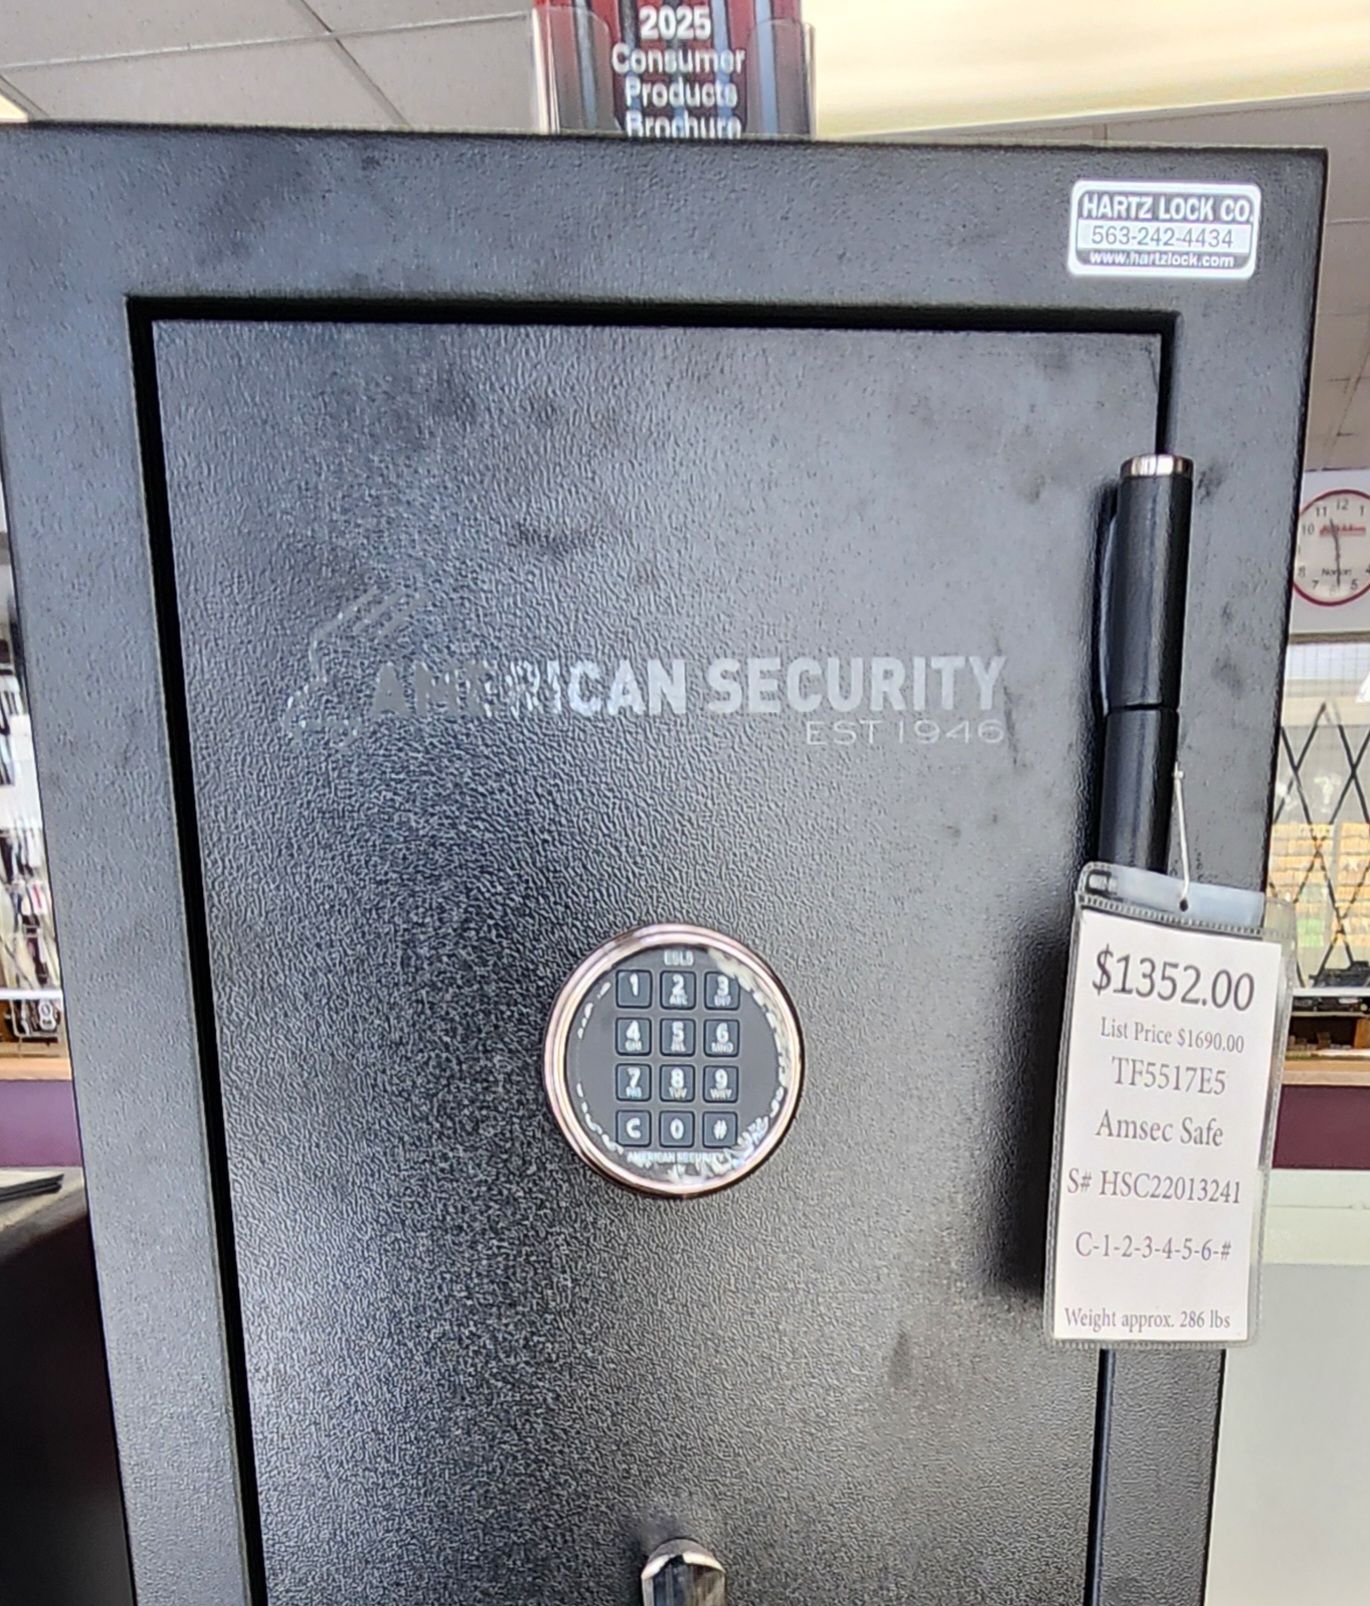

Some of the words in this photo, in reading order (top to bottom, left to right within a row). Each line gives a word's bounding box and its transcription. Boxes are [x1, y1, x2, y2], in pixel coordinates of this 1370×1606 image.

[638, 6, 712, 40] 2025
[611, 43, 746, 74] Consumer
[625, 76, 738, 109] Products
[1082, 193, 1153, 219] HARTZ
[1158, 195, 1214, 221] LOCK
[1091, 225, 1234, 248] 563-242-4434
[1089, 251, 1235, 268] www.hartzlock.com
[1315, 506, 1328, 518] 11
[1336, 499, 1349, 511] 12
[1302, 523, 1315, 535] 10
[372, 659, 686, 719] AMERICAN
[706, 656, 1006, 713] SECURITY
[805, 719, 883, 746] EST
[898, 718, 1004, 745] 1946
[629, 973, 639, 997] 1
[672, 973, 685, 995] 2
[717, 974, 729, 996] 3
[1092, 943, 1255, 1012] $1352.00
[626, 1020, 640, 1041] 4
[672, 1021, 684, 1042] 5
[716, 1022, 729, 1043] 6
[1100, 1016, 1128, 1039] List
[1134, 1022, 1172, 1045] Price
[1176, 1028, 1245, 1054] $1690.00
[627, 1067, 641, 1088] 7
[671, 1067, 684, 1088] 8
[715, 1068, 728, 1090] 9
[1111, 1056, 1226, 1096] TF5517E5
[626, 1117, 641, 1139] C
[670, 1118, 684, 1140] 0
[713, 1119, 727, 1140] #
[1096, 1109, 1173, 1143] Amsec
[1180, 1116, 1224, 1147] Safe
[627, 1151, 675, 1164] AMERICAN
[1067, 1167, 1092, 1194] S#
[1099, 1170, 1241, 1204] HSC22013241
[1075, 1231, 1232, 1262] C-1-2-3-4-5-6-#
[1065, 1307, 1116, 1333] Weight
[1121, 1312, 1174, 1333] approx.
[1180, 1310, 1205, 1328] 286
[1210, 1309, 1231, 1329] lbs
